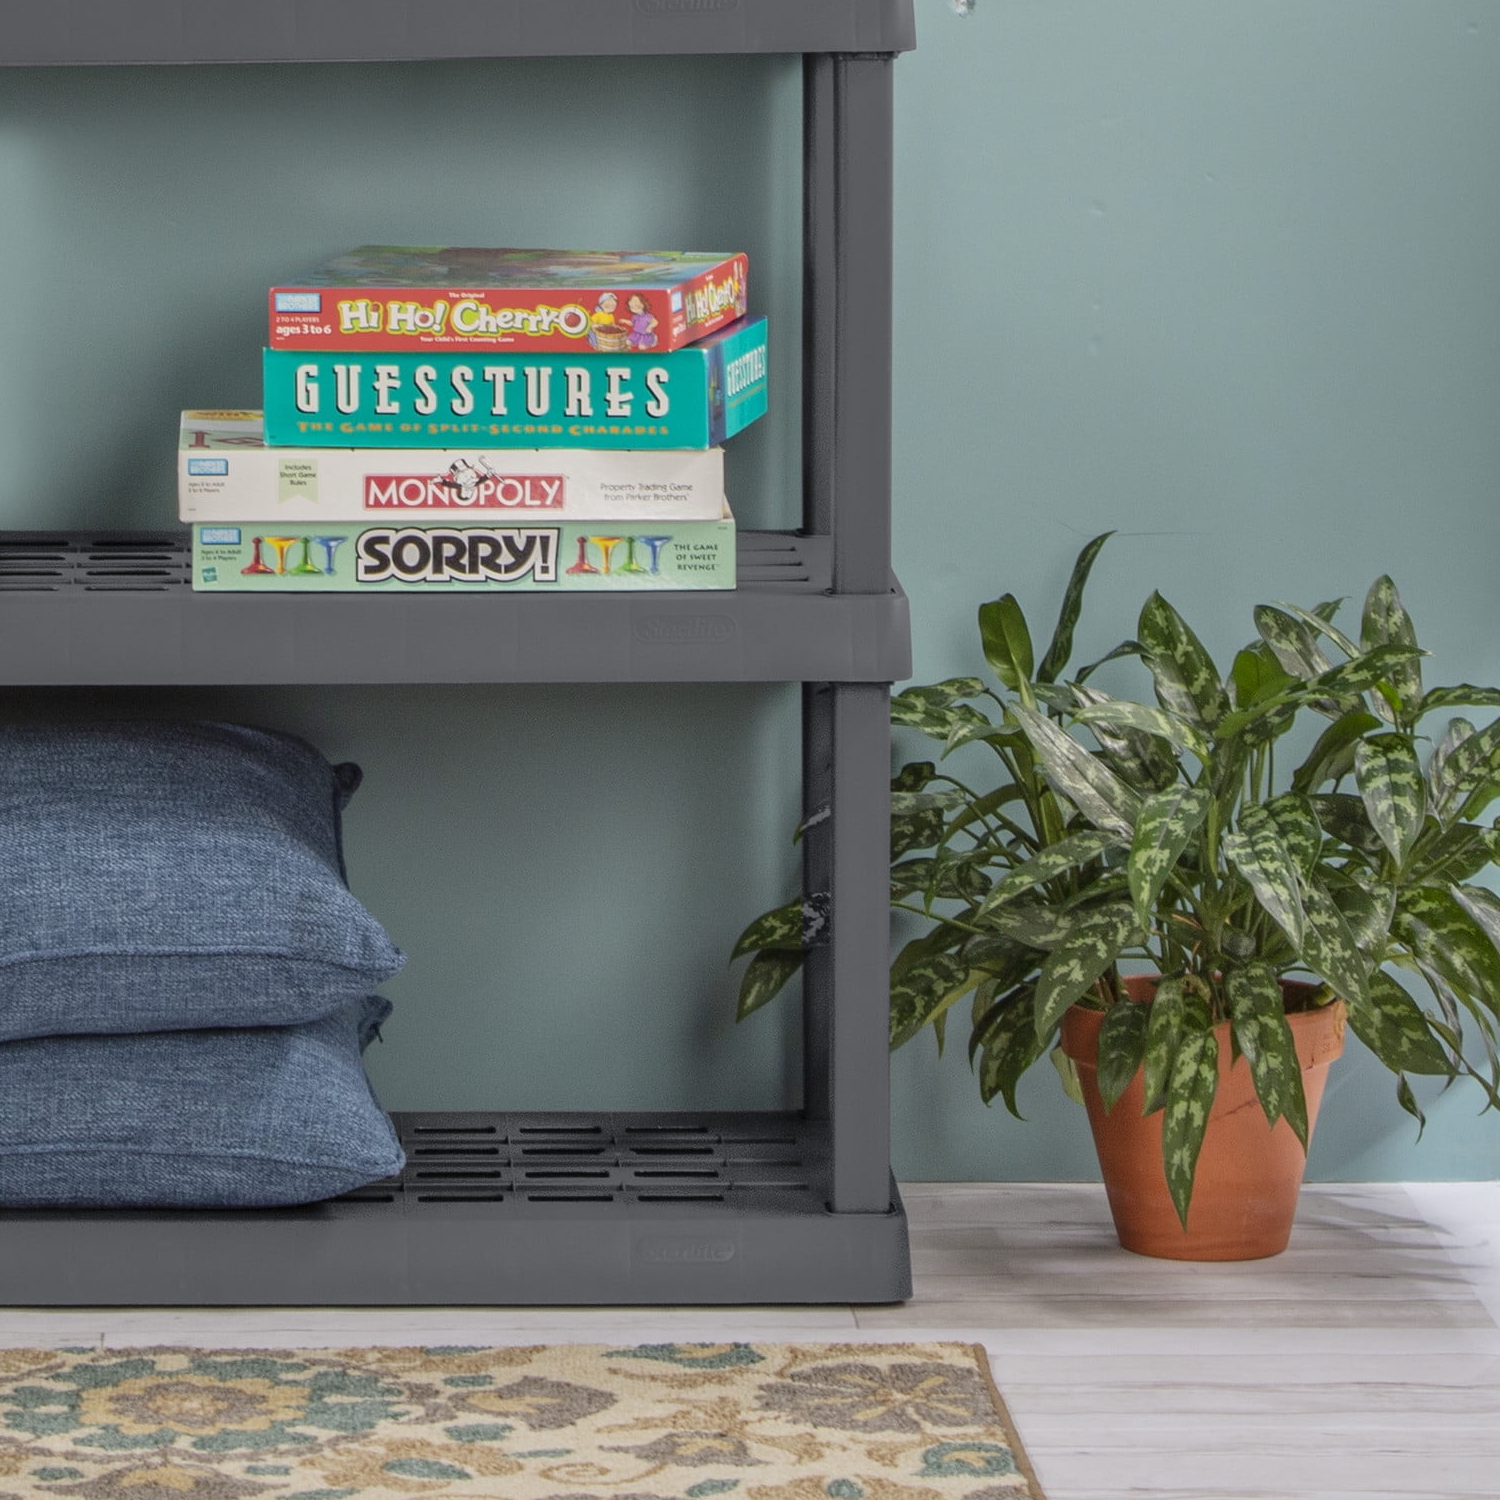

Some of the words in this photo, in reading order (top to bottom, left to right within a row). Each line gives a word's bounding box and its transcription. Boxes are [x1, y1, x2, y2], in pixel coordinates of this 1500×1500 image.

[461, 292, 485, 300] Original
[339, 301, 380, 331] Hi
[388, 301, 447, 333] Ho!
[276, 325, 301, 337] ages
[302, 324, 309, 334] 3
[311, 325, 323, 334] to
[324, 324, 332, 334] 6
[726, 344, 766, 397] GUESSTURES
[295, 364, 671, 418] GUESSTURES
[297, 422, 334, 433] THE
[339, 422, 394, 434] GAME
[400, 423, 422, 432] OF
[428, 423, 563, 435] SPLIT-SECOND
[568, 425, 669, 436] CHARADES
[298, 471, 316, 479] Game
[368, 478, 560, 507] MONOPOLY
[600, 483, 635, 492] Property
[638, 483, 668, 492] Trading
[669, 483, 693, 491] Game
[604, 493, 625, 501] from
[626, 493, 652, 501] Parker
[654, 493, 687, 501] Brothers
[674, 543, 691, 551] THE
[692, 543, 719, 551] GAME
[362, 533, 553, 576] SORRY!
[677, 563, 716, 571] REVENGE
